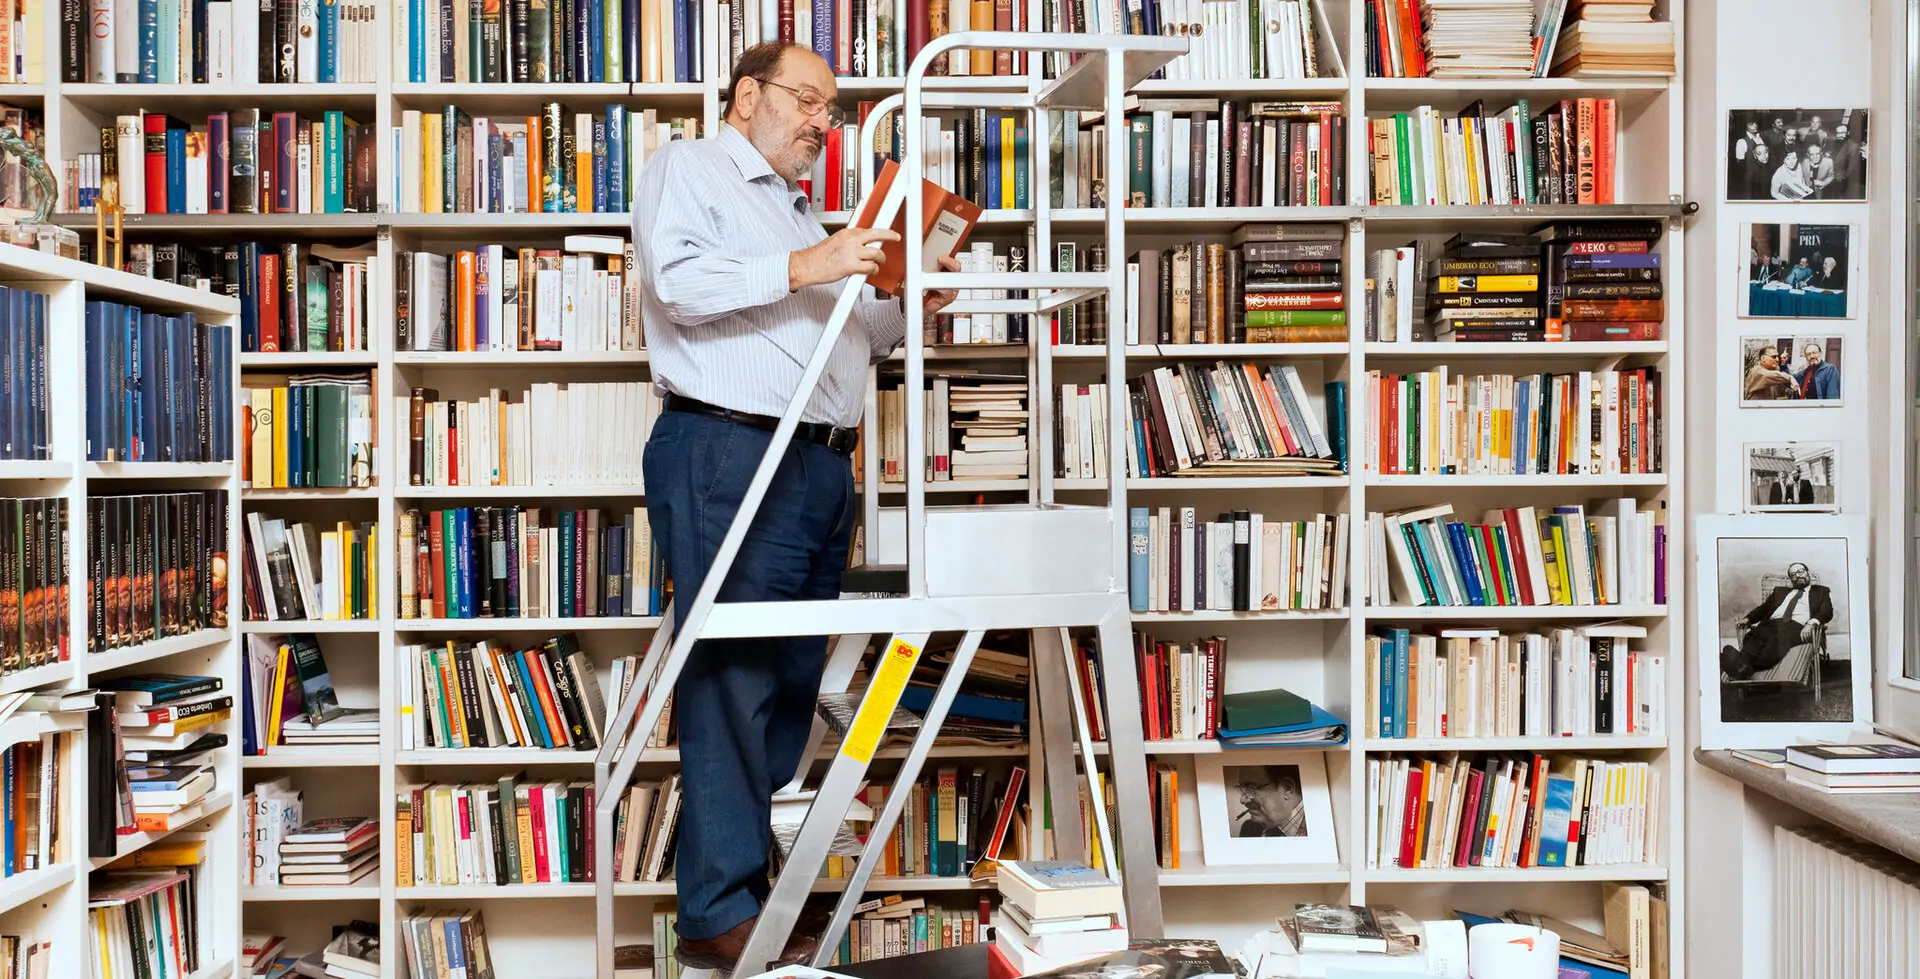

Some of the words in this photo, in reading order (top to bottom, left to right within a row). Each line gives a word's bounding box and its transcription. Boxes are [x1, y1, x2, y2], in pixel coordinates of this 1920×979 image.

[442, 5, 451, 36] Umberto
[578, 8, 588, 21] Eco
[442, 39, 451, 54] Eco
[578, 24, 588, 57] Umberto
[824, 36, 832, 51] ECO
[118, 126, 140, 136] ECO
[1536, 121, 1544, 143] ECO
[564, 135, 573, 157] ECO
[972, 146, 980, 180] Baudolino
[1294, 151, 1304, 173] ECO
[1016, 171, 1024, 200] Baudolino
[1551, 177, 1559, 194] ECO
[1565, 174, 1574, 195] ECO
[1580, 165, 1593, 192] ECO
[156, 252, 175, 262] ECO
[625, 250, 634, 271] ECO
[1060, 248, 1069, 267] ECO
[1293, 263, 1321, 272] ECO
[1443, 262, 1478, 270] UMBERTO
[286, 269, 295, 291] ECO
[335, 282, 343, 308] ECO
[1460, 296, 1472, 306] ECO
[398, 319, 406, 337] ECO
[1621, 399, 1629, 429] Caranguejo
[509, 514, 517, 537] Umberto
[1131, 519, 1148, 527] ECO
[509, 537, 517, 549] Eco
[449, 542, 457, 572] SEMIOTICS
[1398, 634, 1406, 657] Umberto
[1598, 640, 1609, 661] ECO
[1206, 654, 1214, 688] TEMPLARS
[1398, 657, 1406, 673] ECO
[1173, 677, 1181, 693] Films
[190, 702, 213, 712] Umberto
[448, 681, 457, 705] CRITICAL
[453, 706, 461, 735] MOMENT
[1173, 694, 1181, 706] des
[178, 707, 190, 716] ECO
[1173, 707, 1182, 735] Semiotik
[938, 779, 955, 787] Eco
[398, 823, 406, 836] Eco
[398, 839, 408, 878] Umberto
[521, 834, 531, 873] Umberto
